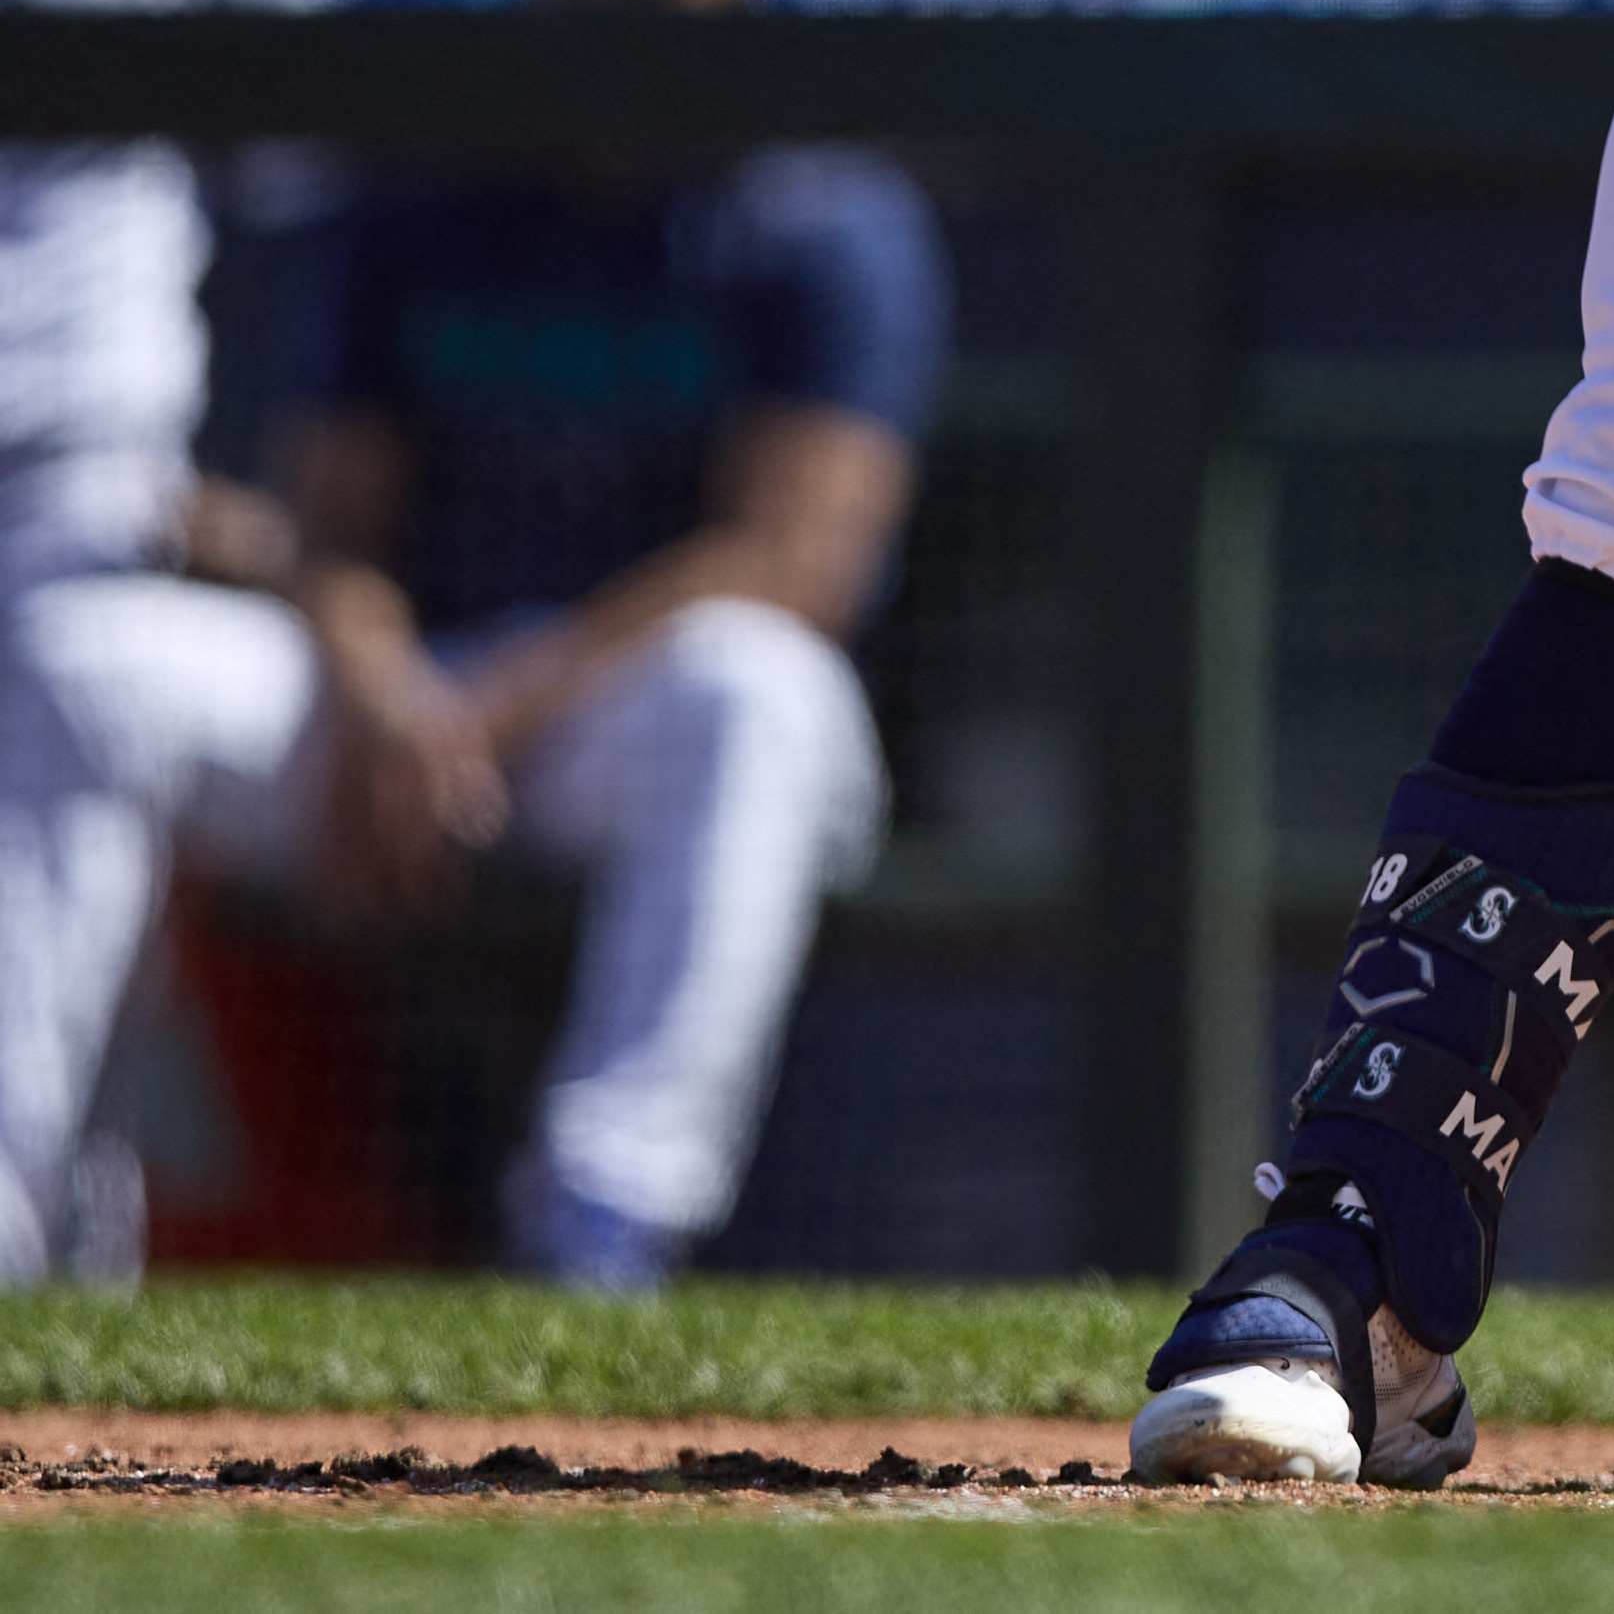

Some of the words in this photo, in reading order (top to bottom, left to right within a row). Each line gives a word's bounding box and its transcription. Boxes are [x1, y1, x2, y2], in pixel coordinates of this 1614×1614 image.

[1360, 852, 1408, 908] 18
[1533, 939, 1600, 1040] M
[1439, 1090, 1520, 1198] MA
